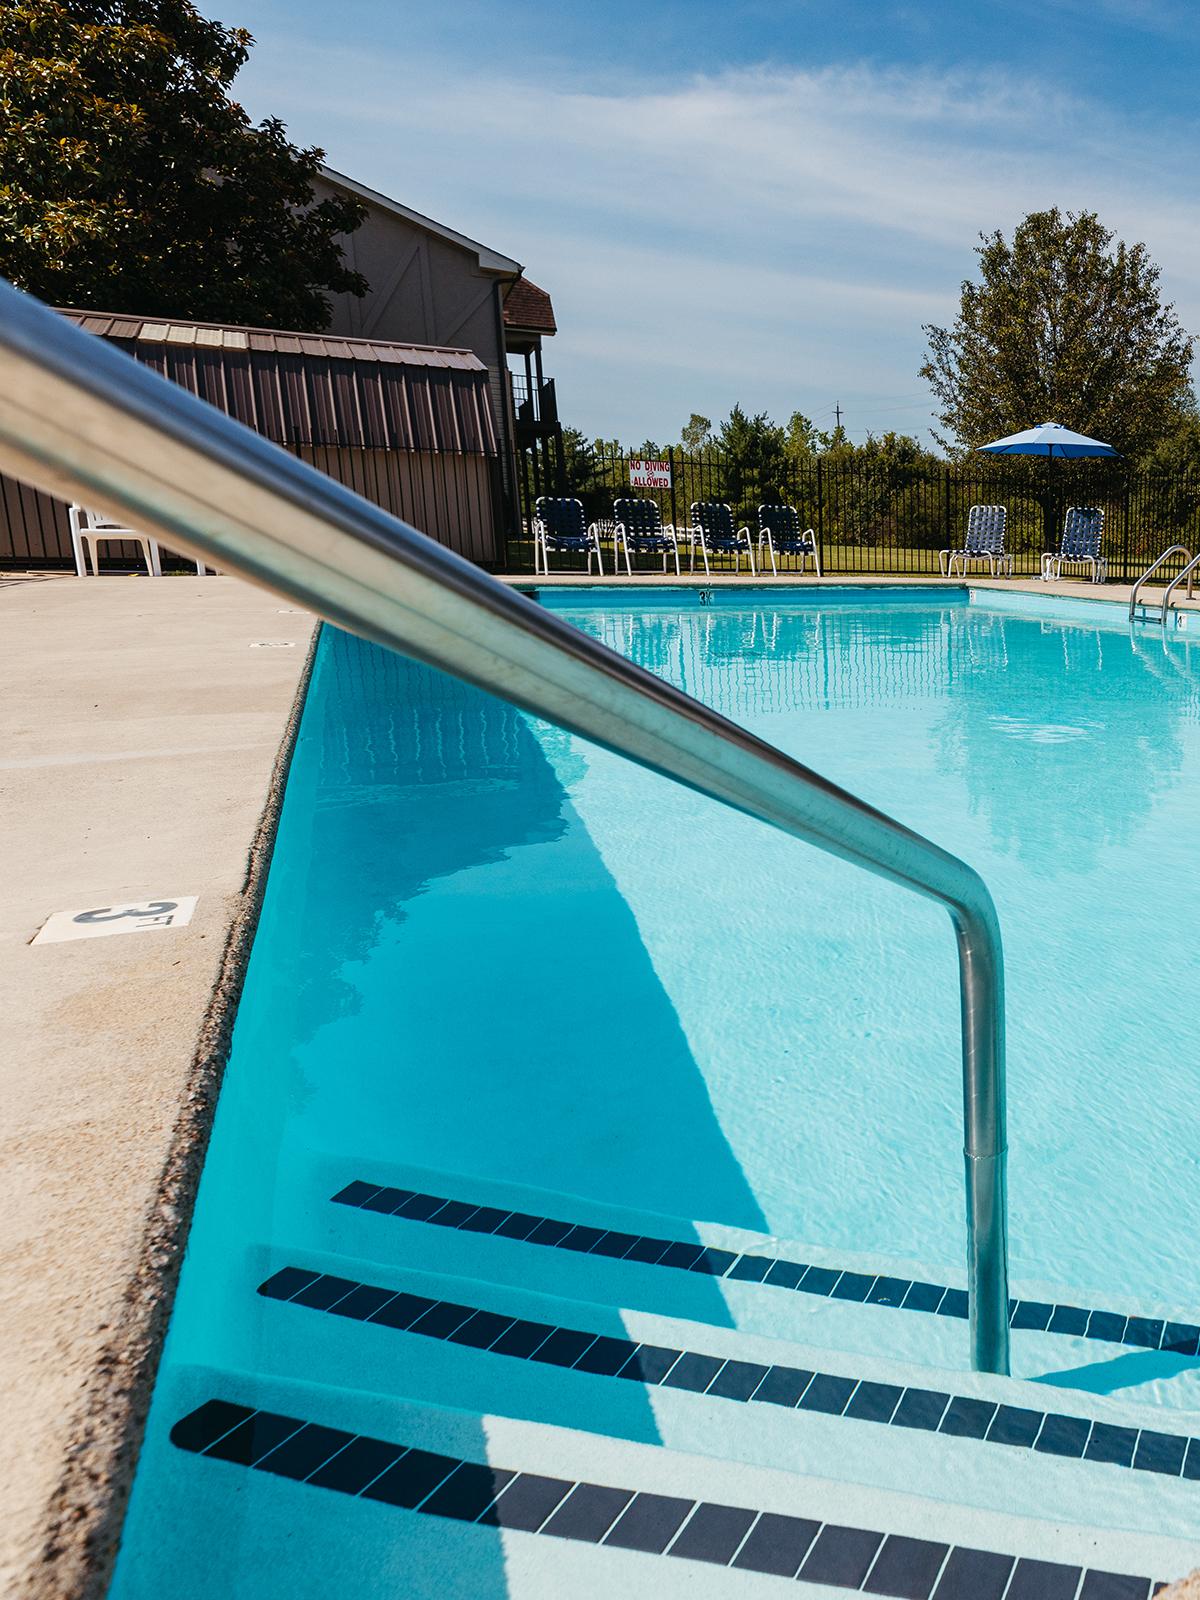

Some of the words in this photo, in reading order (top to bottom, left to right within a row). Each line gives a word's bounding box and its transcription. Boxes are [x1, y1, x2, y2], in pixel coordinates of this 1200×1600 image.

[630, 460, 641, 470] NO
[645, 461, 670, 472] DIVING
[633, 477, 669, 487] ALLOWED
[72, 902, 178, 924] 3
[135, 914, 174, 928] FT
